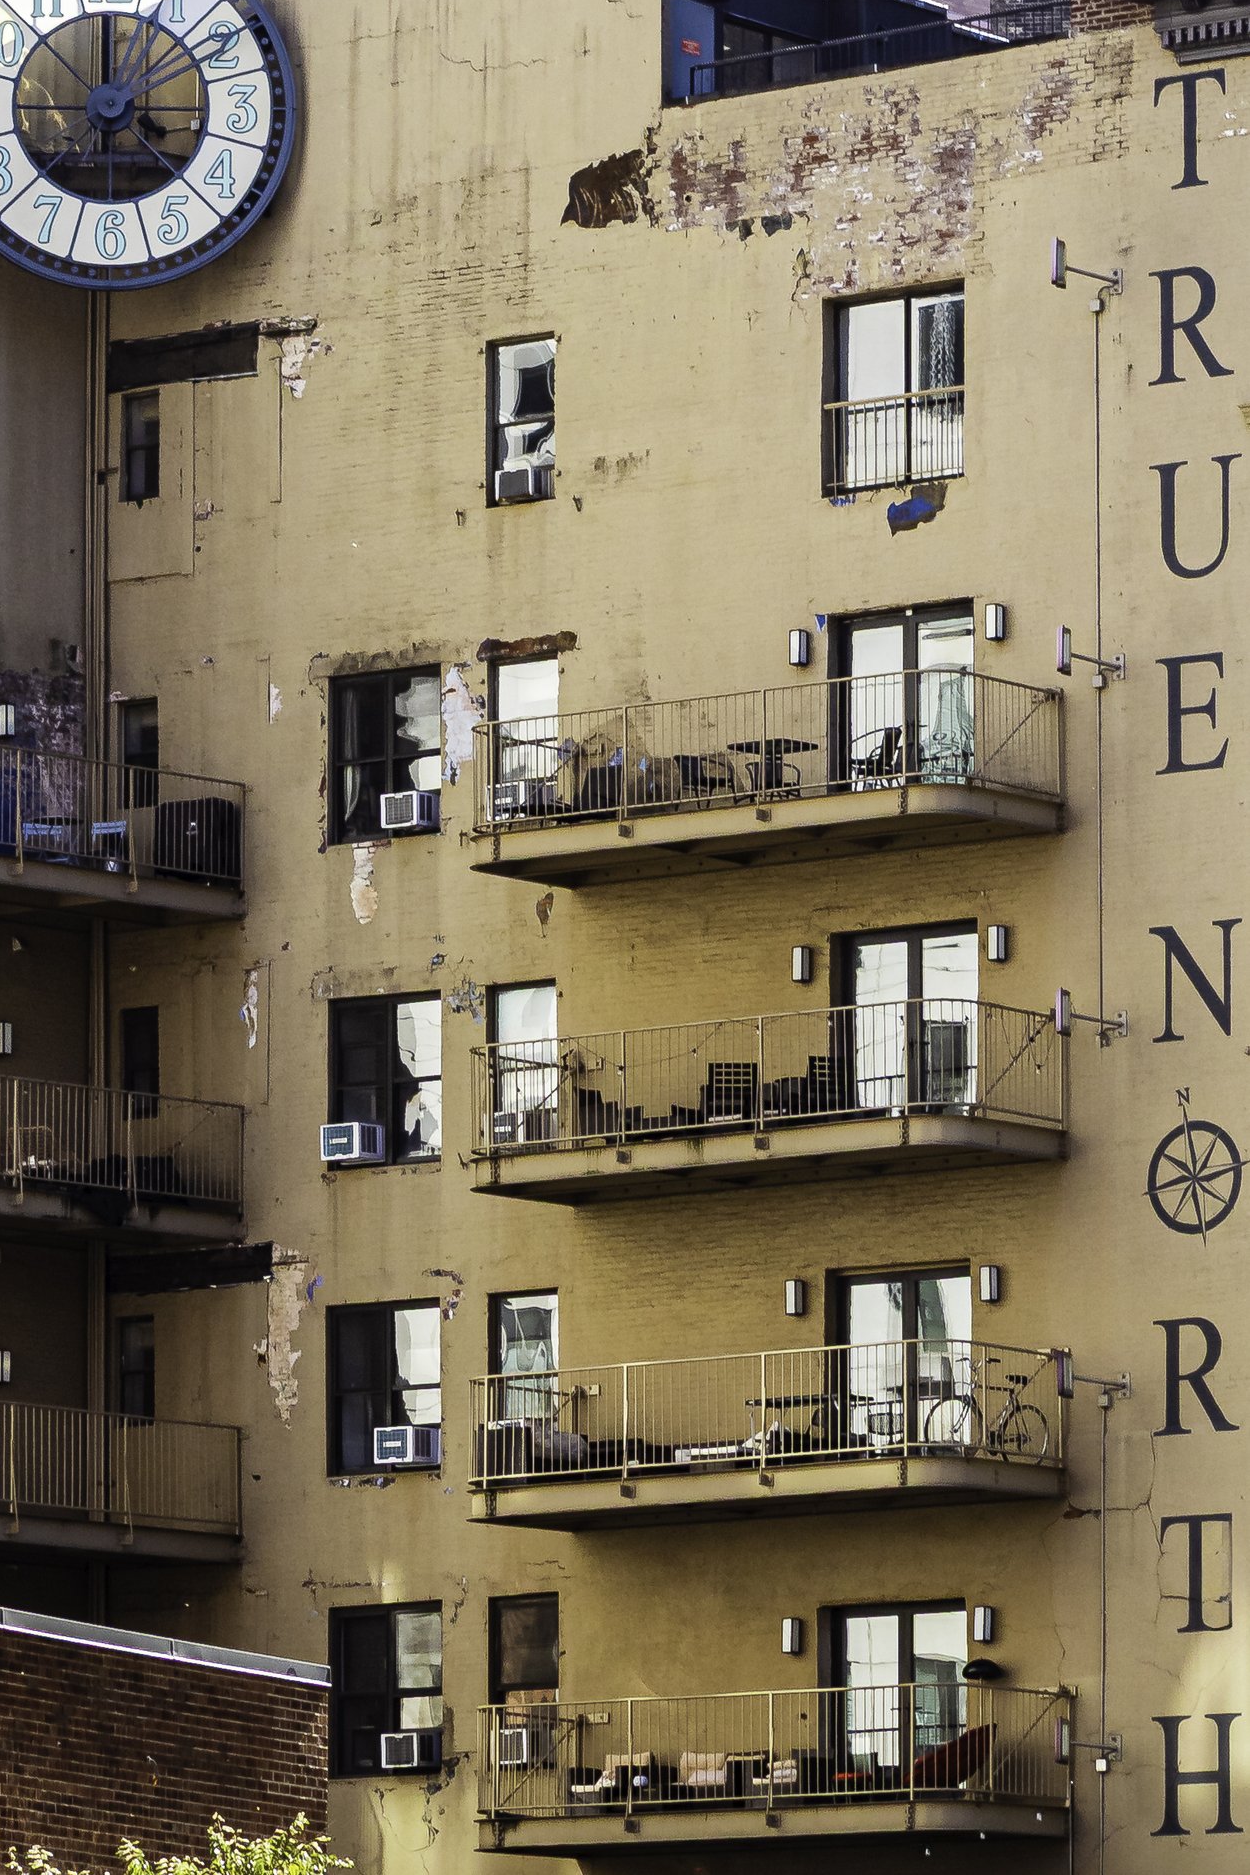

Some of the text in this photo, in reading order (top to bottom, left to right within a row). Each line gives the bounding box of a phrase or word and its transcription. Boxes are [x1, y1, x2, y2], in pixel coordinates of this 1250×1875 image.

[209, 21, 240, 69] 2
[226, 84, 258, 134] 3
[203, 149, 236, 199] 4
[33, 195, 63, 244] 7
[94, 209, 127, 260] 6
[157, 195, 189, 245] 5
[1147, 67, 1243, 777] TRUE
[1175, 1087, 1191, 1107] N
